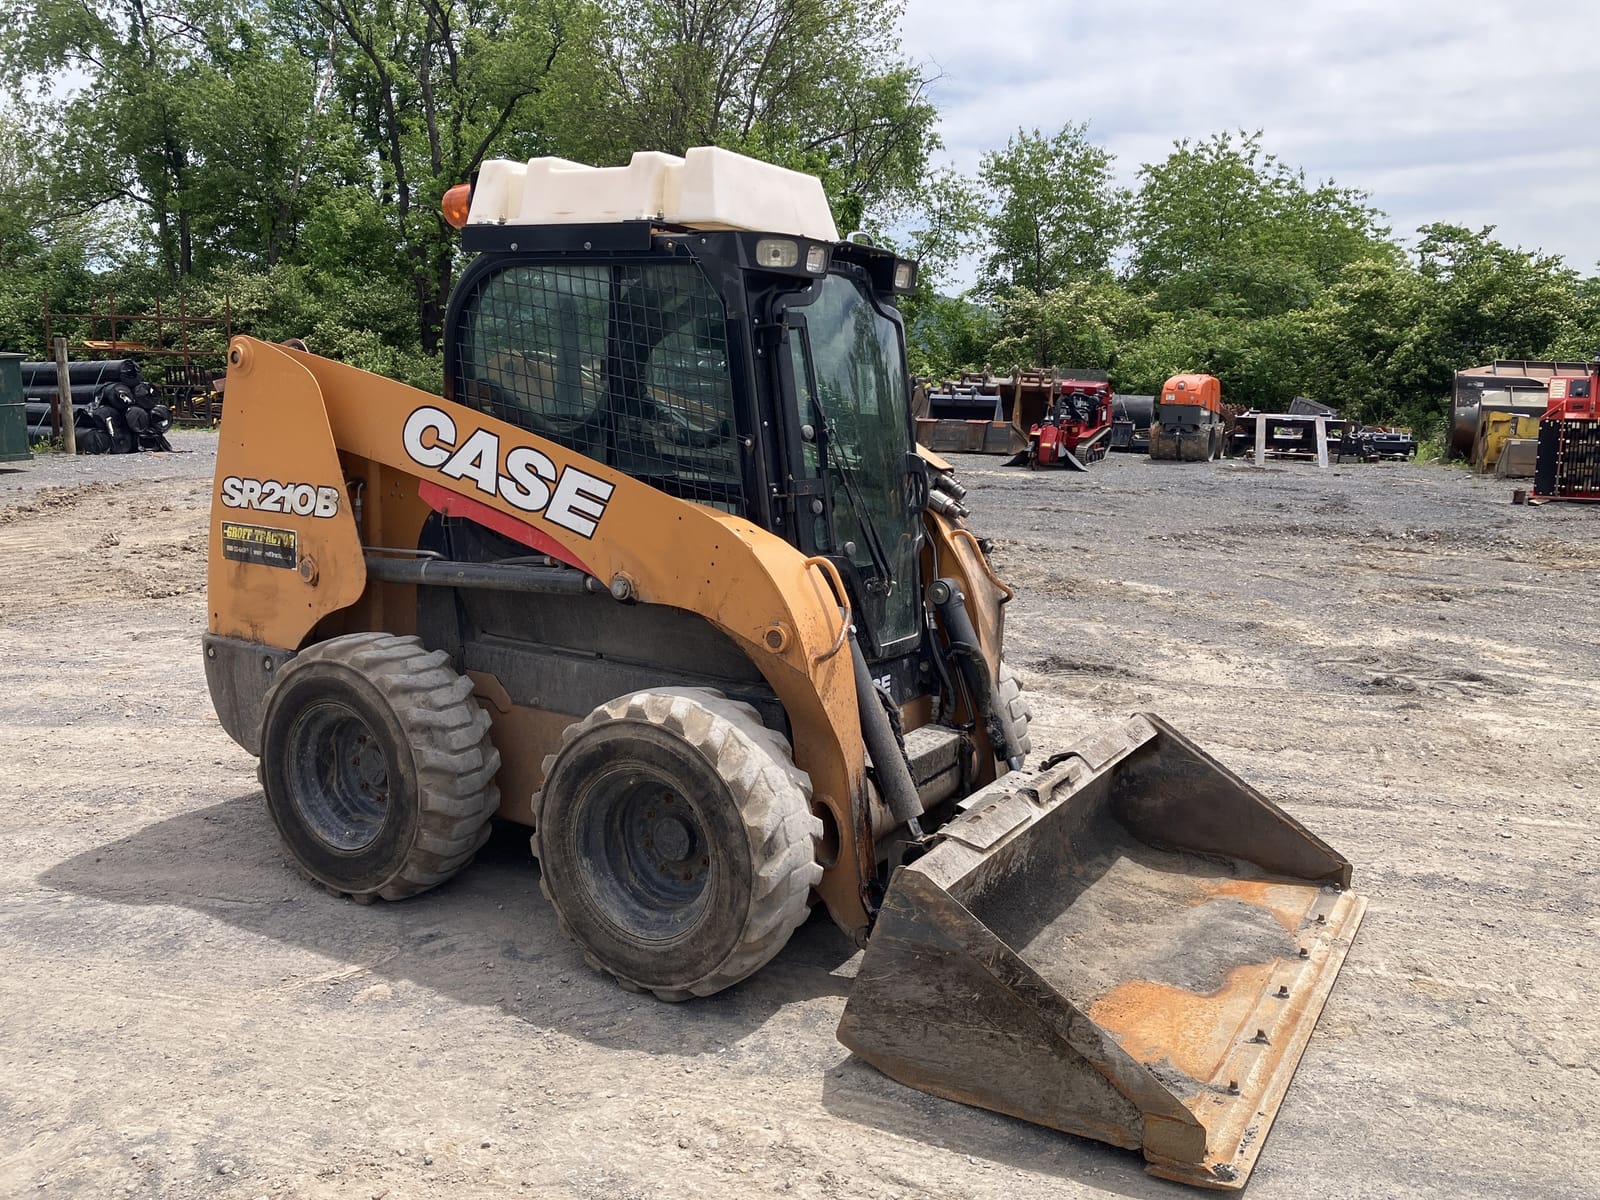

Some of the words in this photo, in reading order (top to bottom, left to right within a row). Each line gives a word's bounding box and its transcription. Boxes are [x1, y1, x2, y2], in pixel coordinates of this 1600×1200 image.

[402, 405, 616, 540] CASE
[221, 476, 340, 519] SR210B
[226, 526, 253, 540] GROFF
